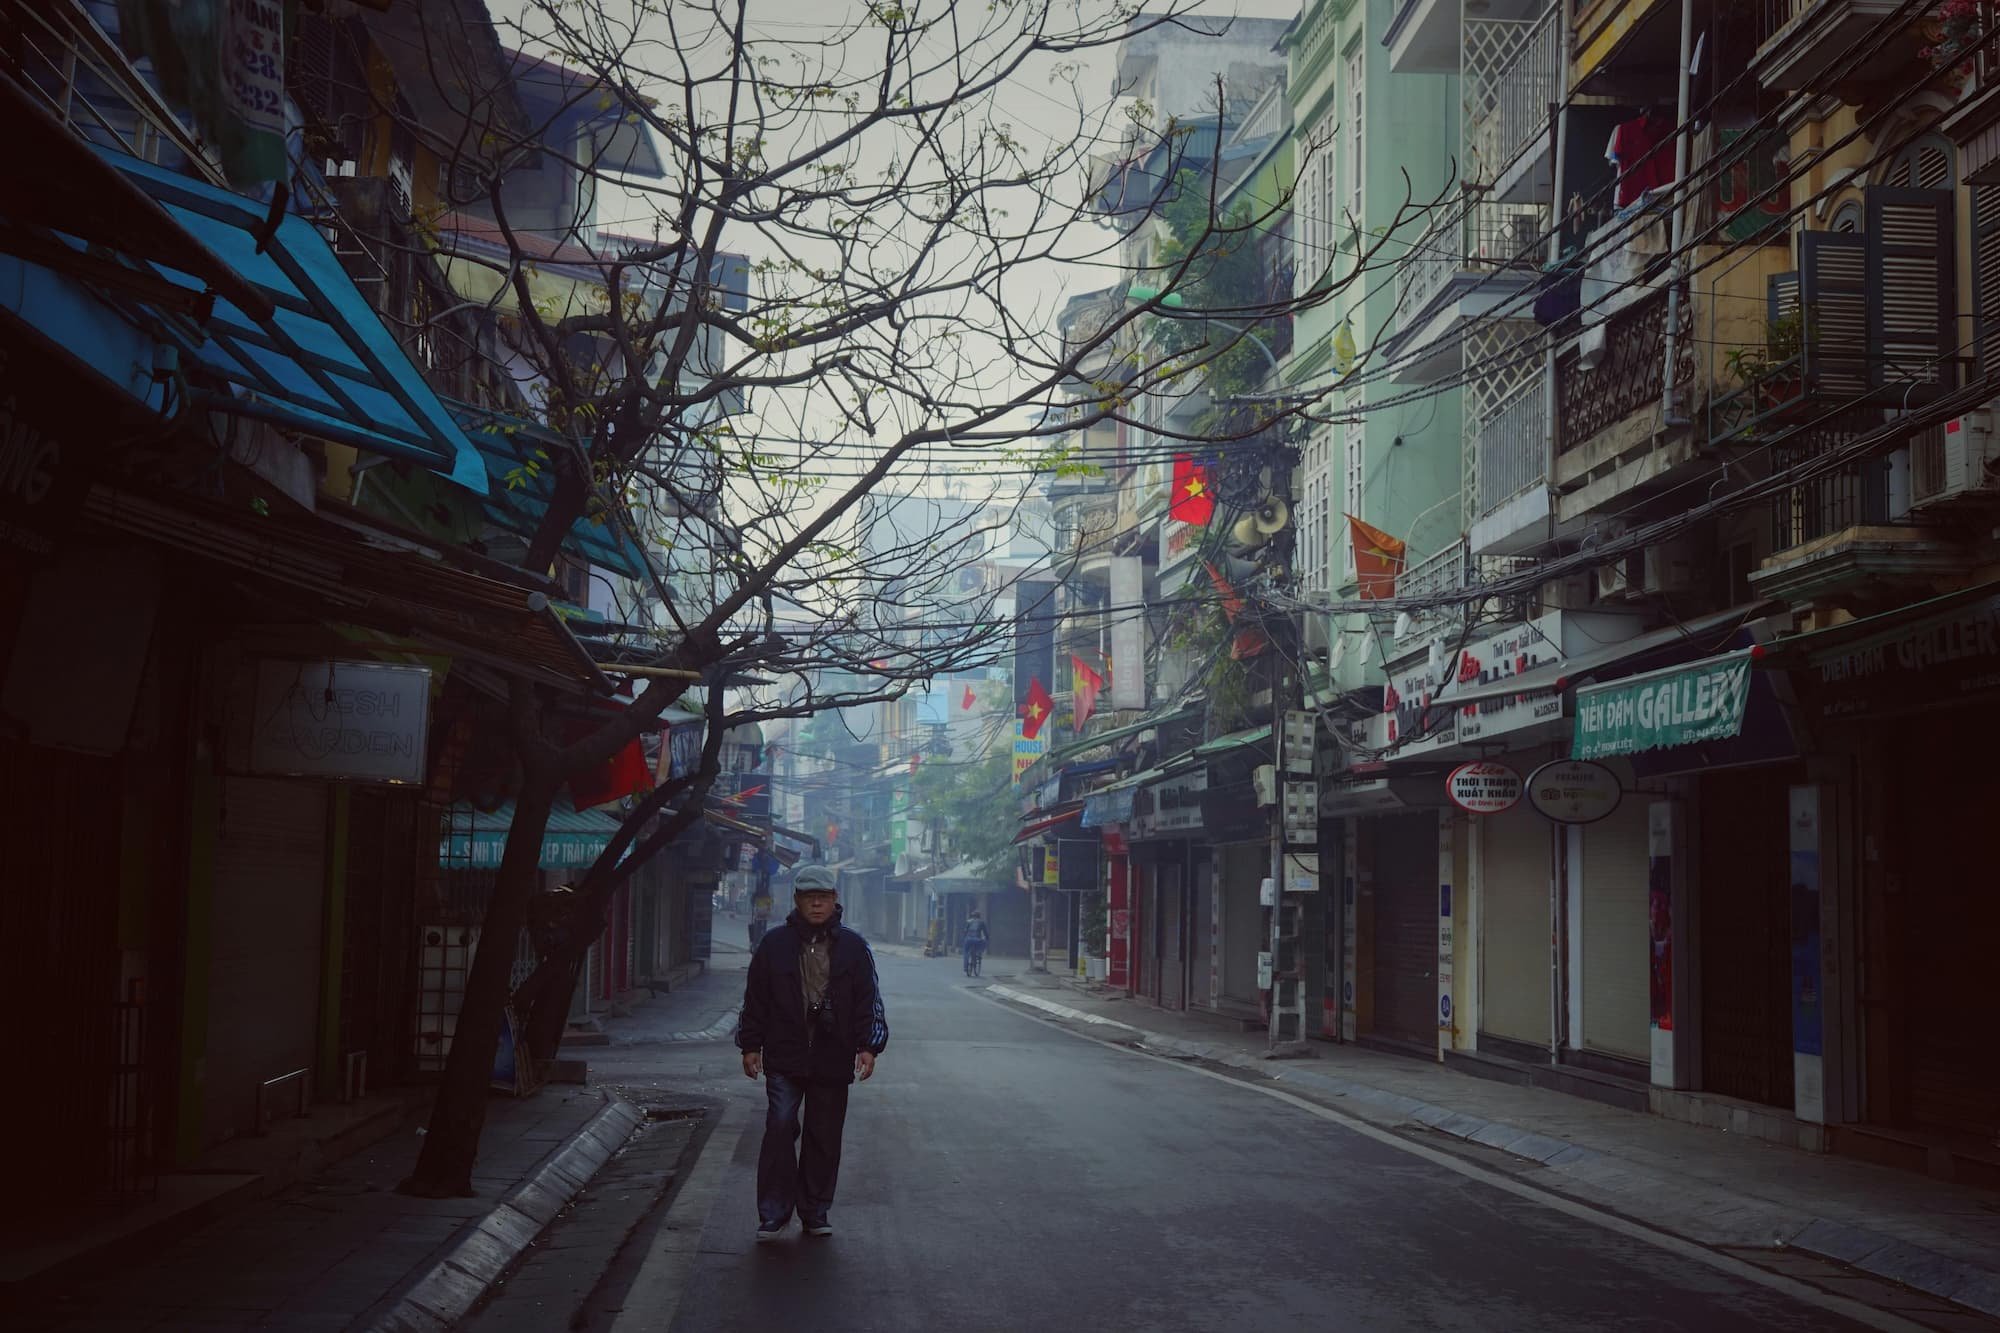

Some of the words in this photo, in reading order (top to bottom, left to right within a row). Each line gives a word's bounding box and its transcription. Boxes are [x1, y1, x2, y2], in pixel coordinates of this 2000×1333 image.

[1638, 667, 1747, 731] GALLERY
[1484, 777, 1517, 787] TRANG
[463, 839, 489, 863] SINH
